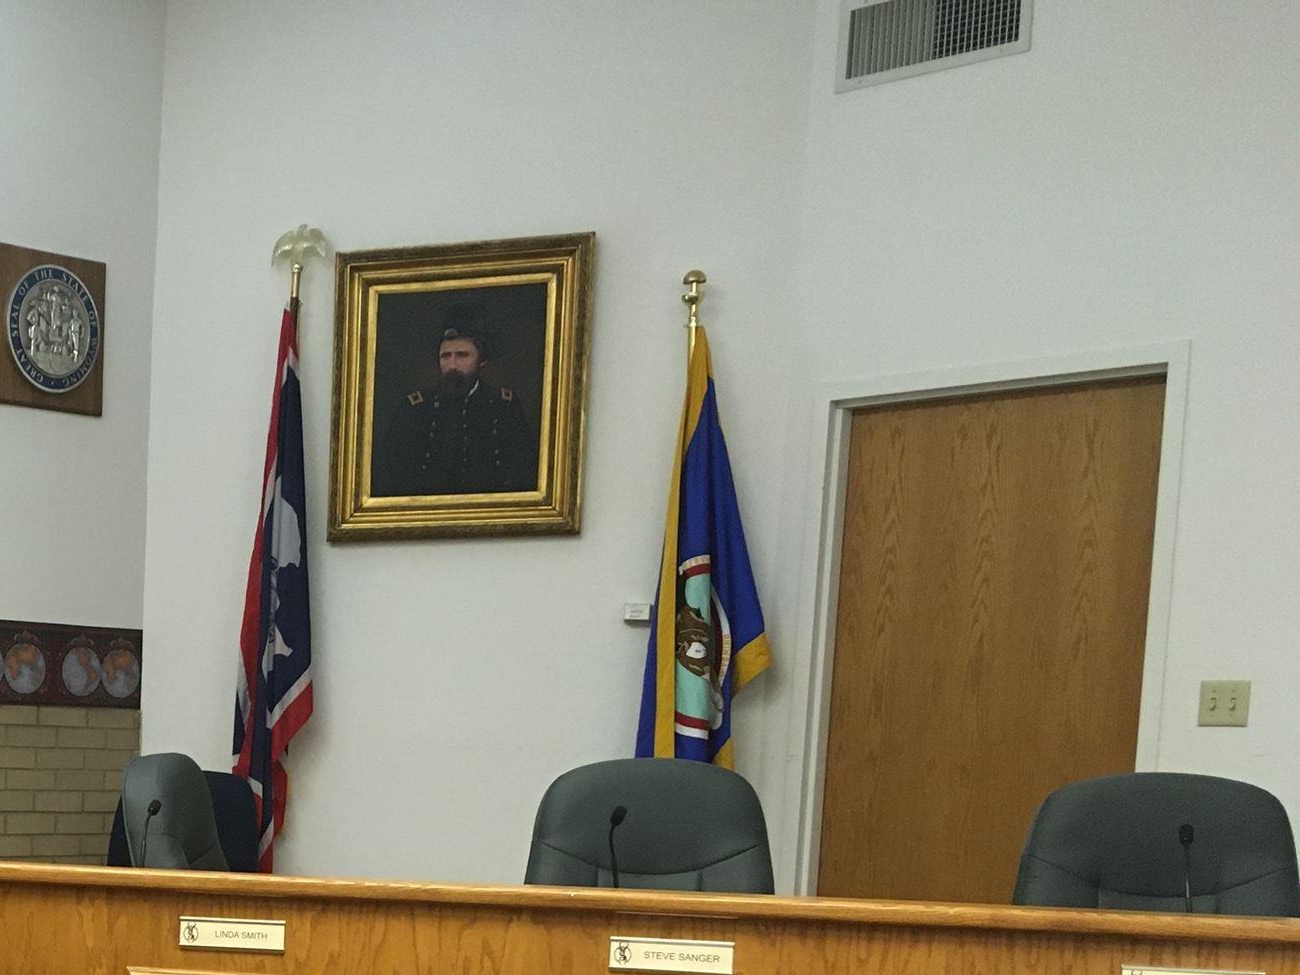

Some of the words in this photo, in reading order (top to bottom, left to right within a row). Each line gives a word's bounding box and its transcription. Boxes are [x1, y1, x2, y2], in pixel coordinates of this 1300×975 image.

[18, 282, 30, 296] OF
[34, 269, 53, 282] THE
[62, 272, 88, 302] STATE
[215, 930, 240, 938] LINDA
[241, 932, 268, 940] SMITH
[643, 951, 675, 960] STEVE
[678, 953, 720, 963] SANGER
